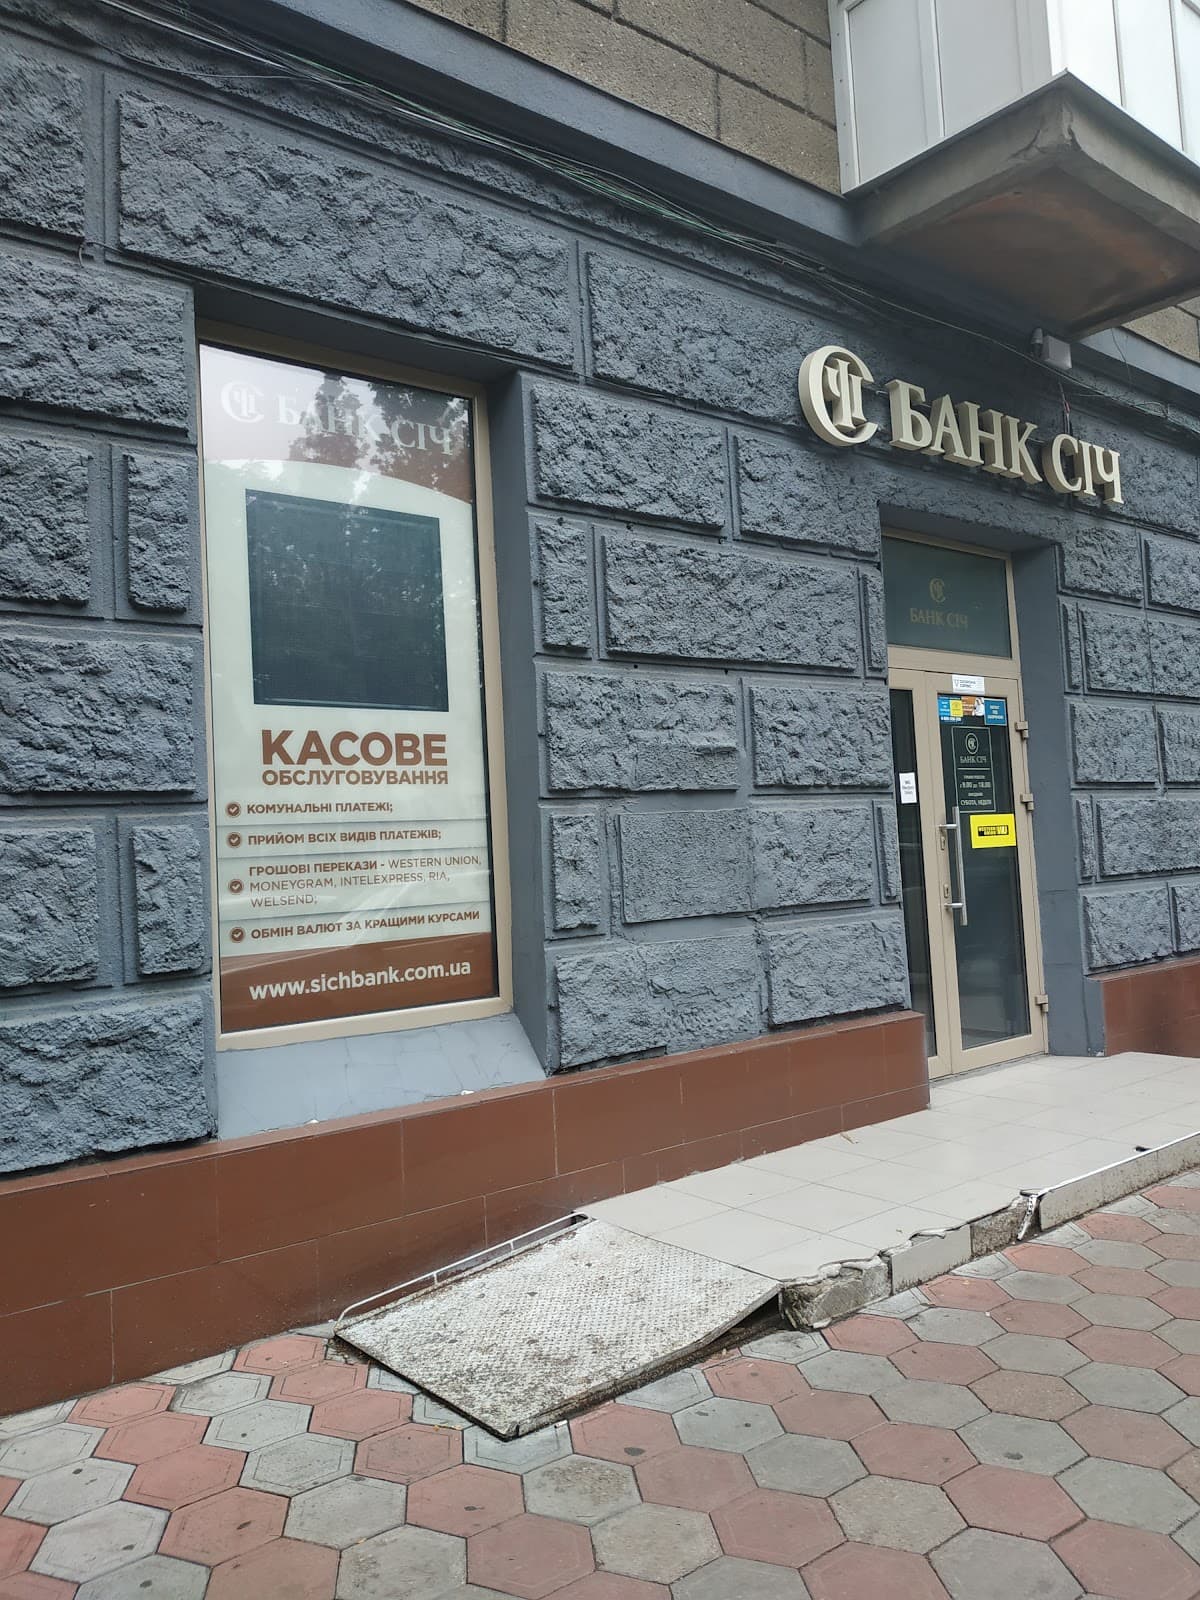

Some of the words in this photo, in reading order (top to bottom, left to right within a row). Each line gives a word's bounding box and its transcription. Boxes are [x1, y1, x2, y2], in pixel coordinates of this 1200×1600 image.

[276, 394, 387, 442] БАНК
[391, 421, 453, 455] СІЧ
[885, 379, 1043, 484] БАНК
[1041, 433, 1124, 504] СІЧ
[909, 607, 945, 626] БАНК
[946, 612, 969, 631] СІЧ
[262, 730, 448, 766] КАСОВЕ
[960, 755, 976, 764] БАНК
[262, 770, 449, 786] ОБСЛУГОВУВАННЯ
[247, 803, 332, 814] КОМУНАЛЬНІ
[335, 802, 393, 813] ПЛАТЕЖІ;
[248, 832, 305, 845] ПРИЙОМ
[308, 832, 336, 844] ВСІХ
[340, 831, 376, 842] ВИДІВ
[379, 829, 441, 841] ПЛАТЕЖІВ;
[249, 863, 310, 877] ГРОШОВІ
[314, 860, 378, 873] ПЕРЕКАЗИ
[388, 856, 442, 869] WESTERN
[445, 855, 482, 866] UNION,
[250, 877, 337, 892] MONEYGRAM,
[340, 871, 426, 888] INTELEXPRESS,
[429, 871, 450, 882] RIA,
[250, 894, 318, 908] WELSEND;
[251, 926, 294, 939] ОБМІН
[297, 922, 342, 935] ВАЛЮТ
[345, 921, 362, 932] ЗА
[365, 915, 425, 929] КРАЩИМИ
[428, 911, 480, 923] КУРСАМИ
[249, 960, 471, 1001] www.sichbank.com.ua
